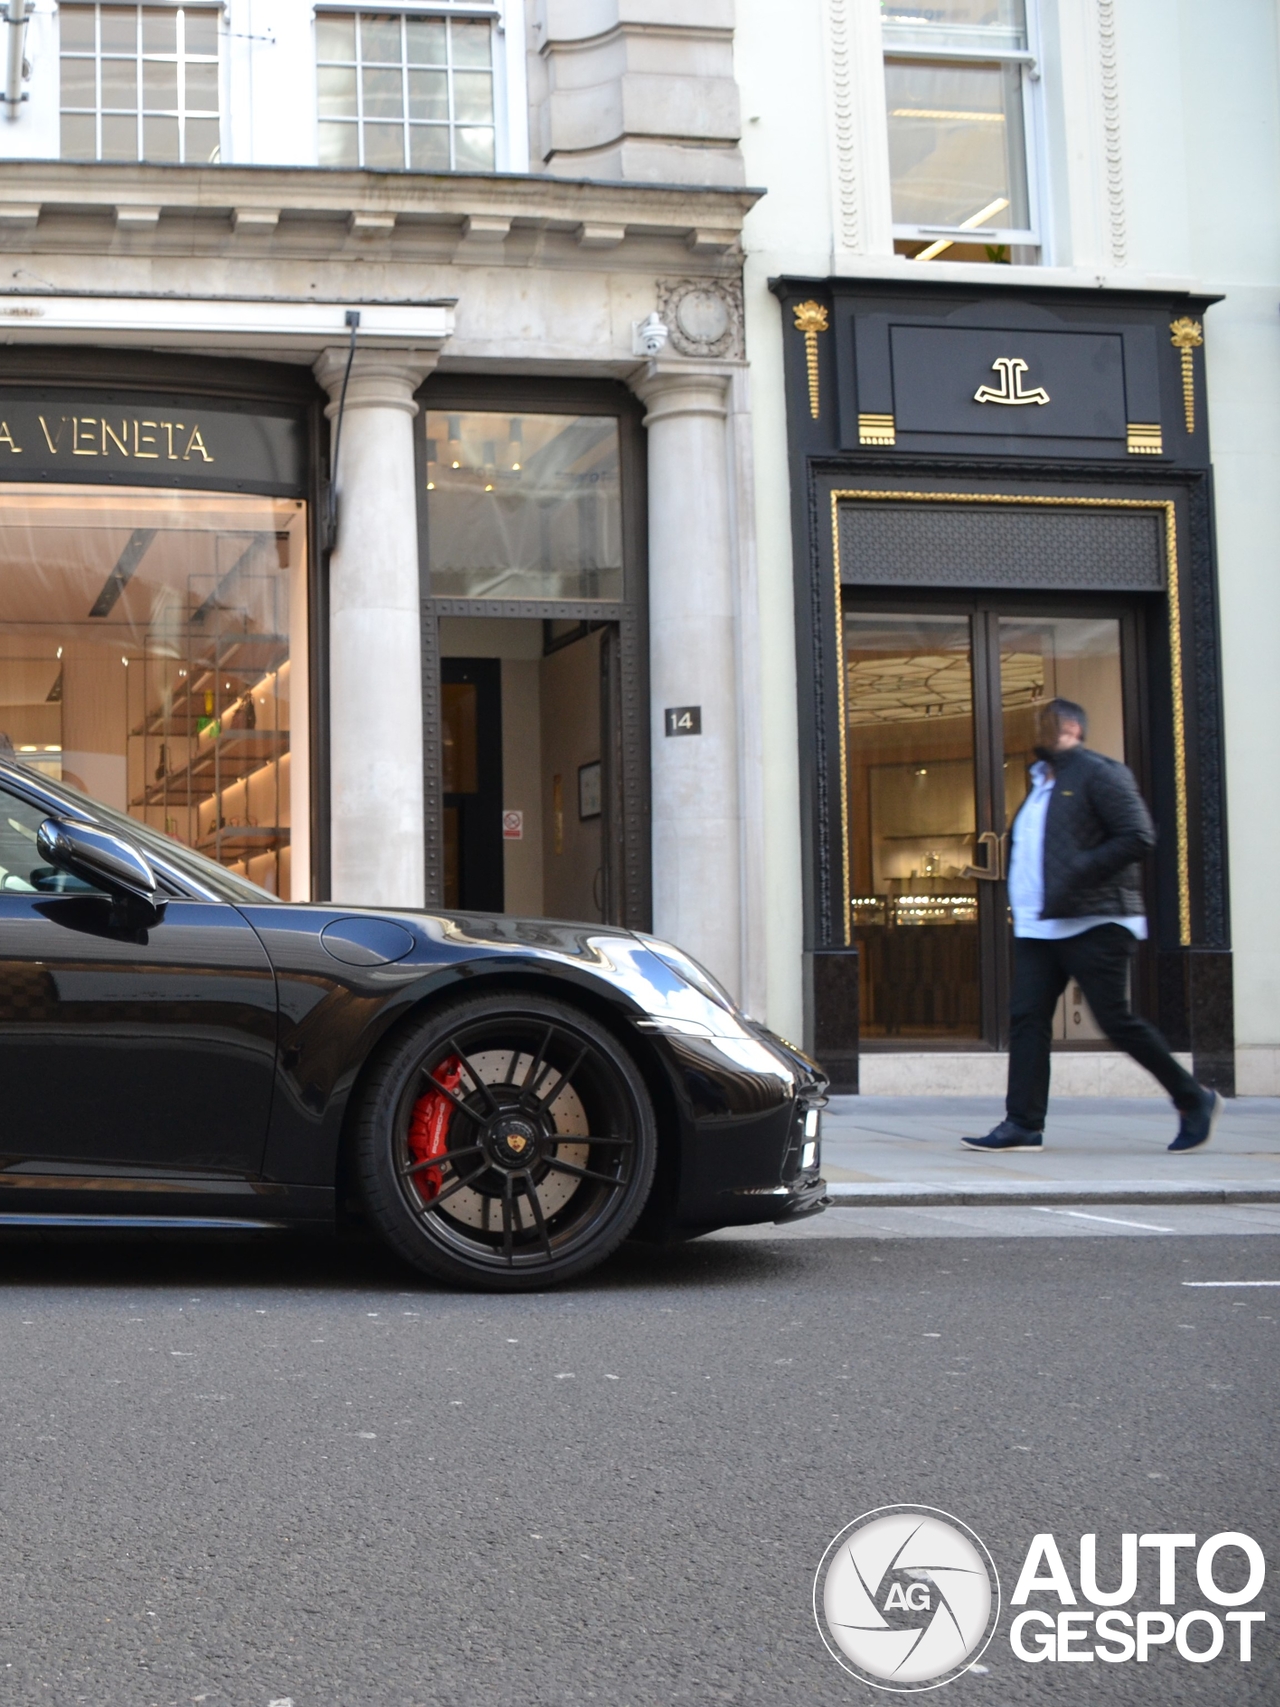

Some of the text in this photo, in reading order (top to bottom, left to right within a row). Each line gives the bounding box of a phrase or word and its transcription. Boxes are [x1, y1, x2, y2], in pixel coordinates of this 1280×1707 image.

[38, 415, 214, 462] VENETA
[670, 711, 694, 730] 14
[432, 1102, 446, 1154] PORSCHE
